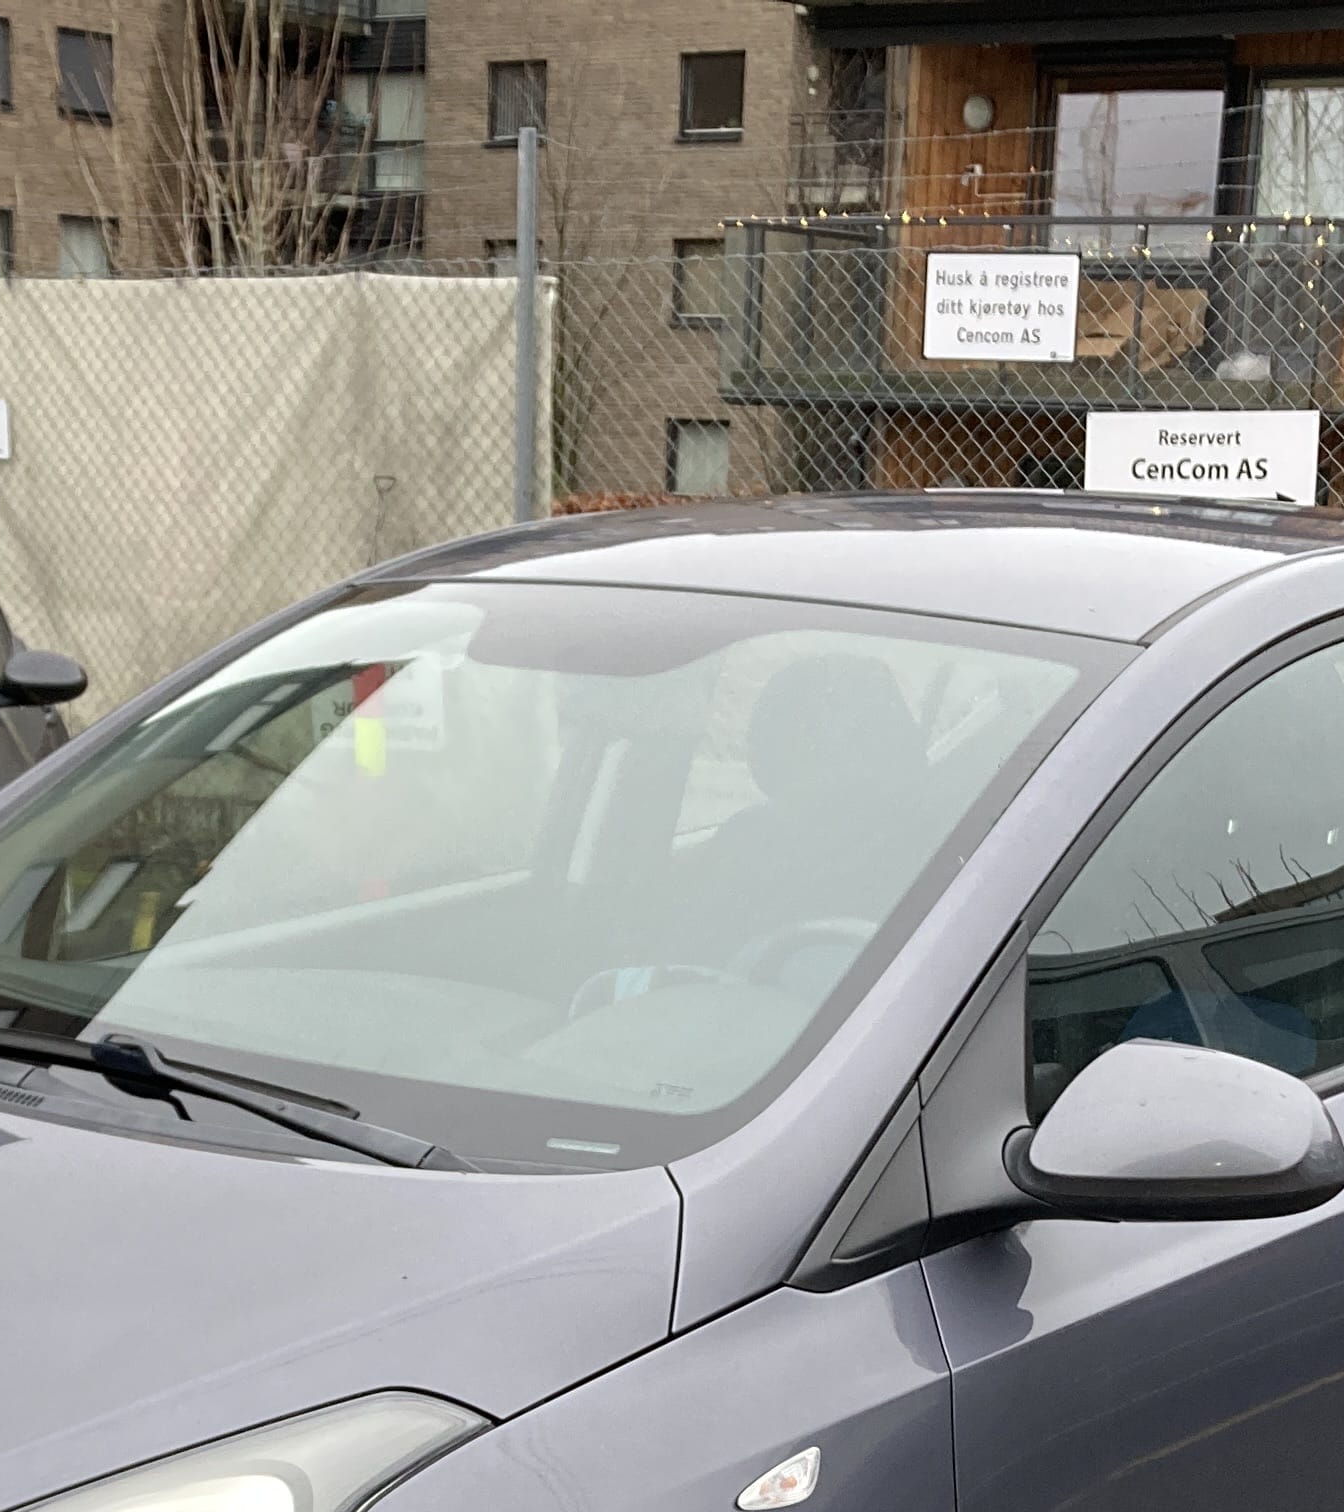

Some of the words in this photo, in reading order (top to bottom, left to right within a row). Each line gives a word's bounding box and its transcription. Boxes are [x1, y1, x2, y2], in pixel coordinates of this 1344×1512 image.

[935, 269, 973, 286] Husk
[979, 270, 988, 287] å
[994, 270, 1069, 290] registrere
[936, 299, 963, 315] ditt
[969, 299, 1030, 319] kjøretøy
[1037, 300, 1065, 316] hos
[956, 326, 1014, 343] Cencom
[1020, 328, 1041, 343] AS
[1158, 429, 1241, 446] Reservert
[1131, 458, 1230, 480] CenCom
[1236, 458, 1268, 480] AS
